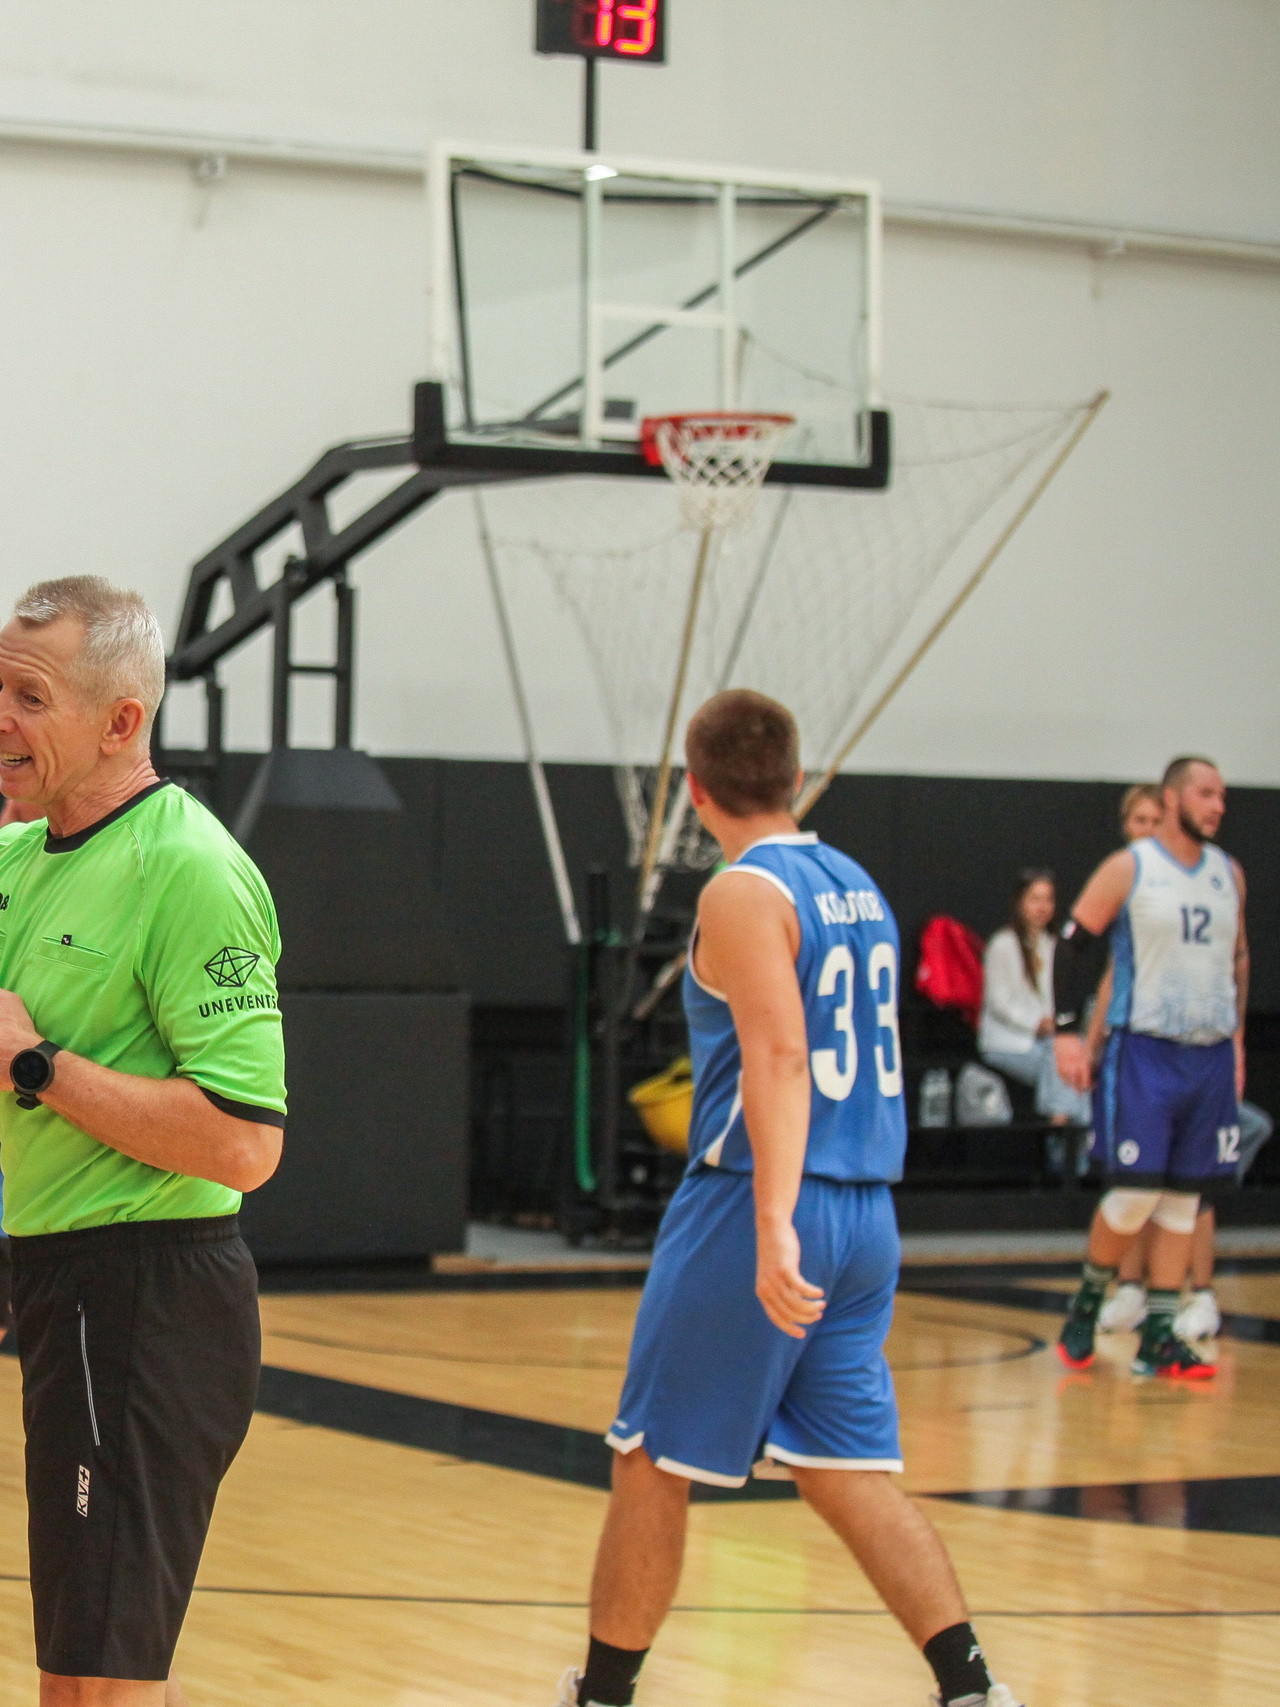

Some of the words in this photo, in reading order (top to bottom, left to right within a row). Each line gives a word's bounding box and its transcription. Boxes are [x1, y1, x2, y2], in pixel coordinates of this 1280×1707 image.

[596, 0, 658, 55] 13
[1180, 905, 1212, 945] 12
[810, 942, 903, 1101] 33
